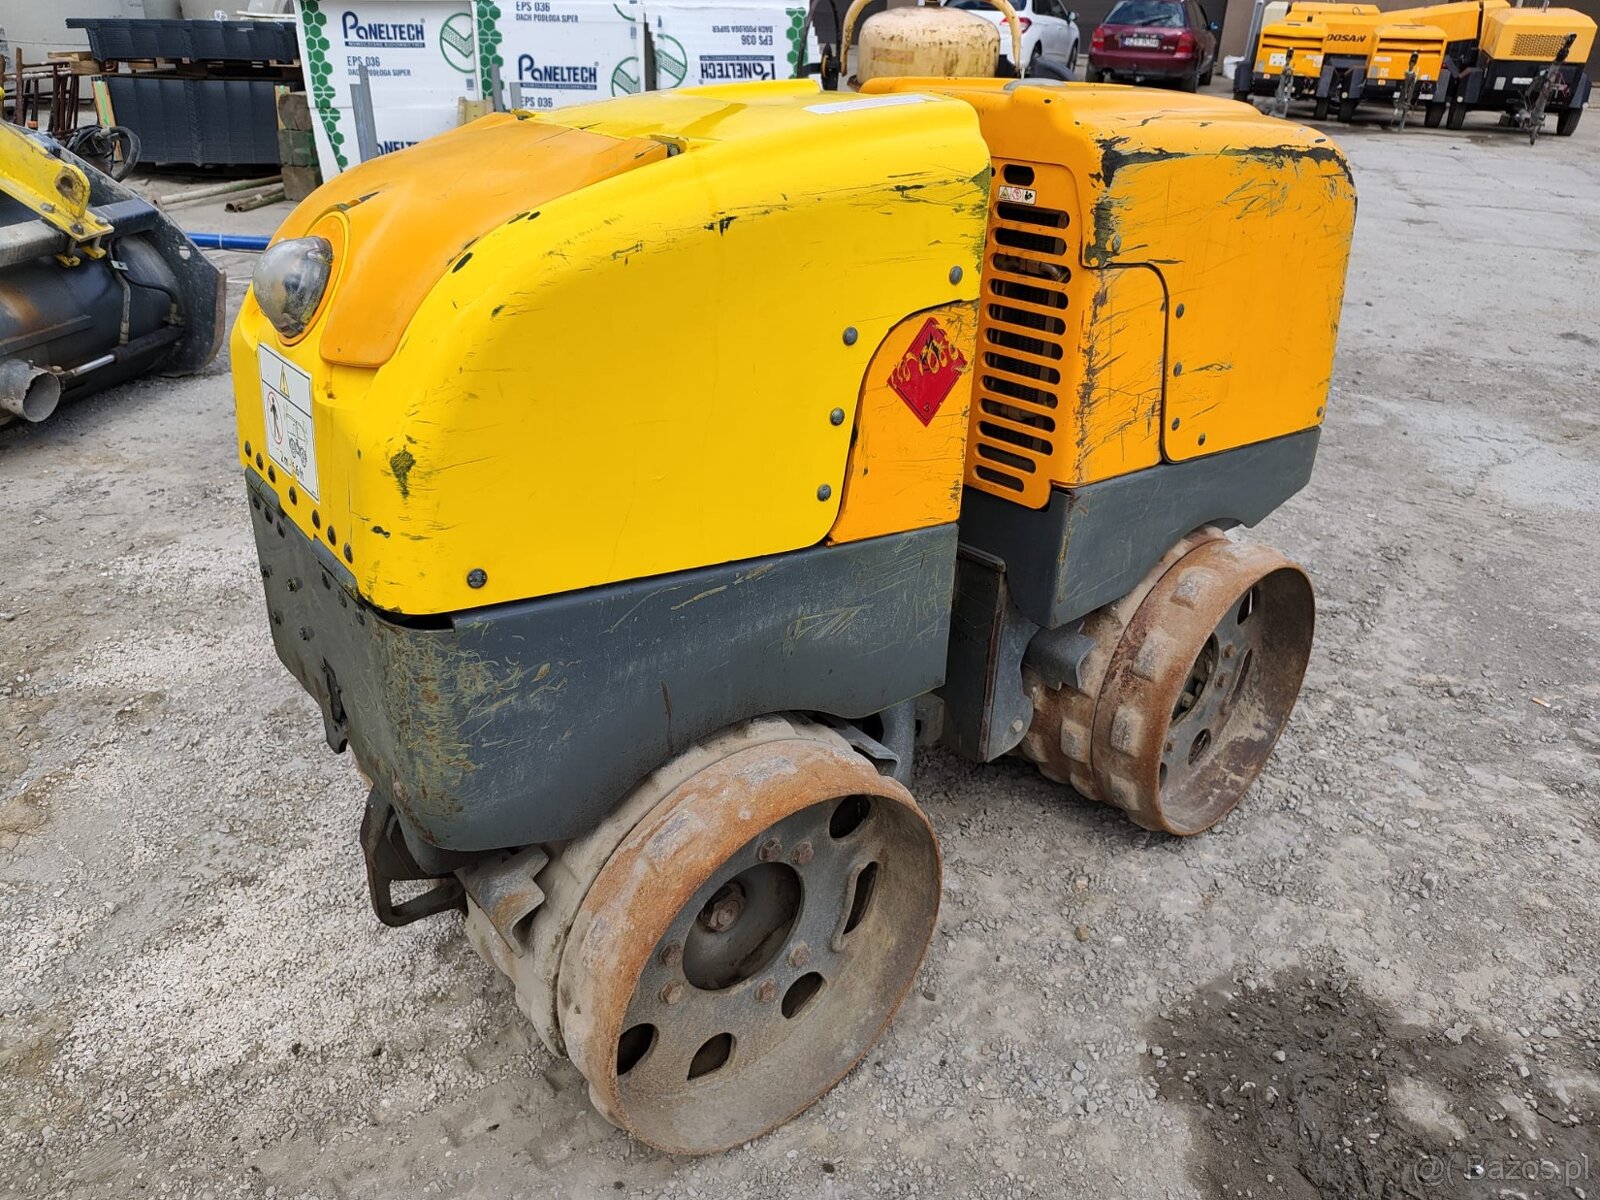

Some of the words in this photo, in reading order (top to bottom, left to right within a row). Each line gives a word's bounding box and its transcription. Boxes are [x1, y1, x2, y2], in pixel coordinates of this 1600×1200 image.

[516, 2, 532, 12] EPS
[534, 2, 550, 12] 036
[516, 13, 532, 22] DACH
[741, 35, 756, 46] 036
[758, 35, 773, 46] EPS
[347, 56, 363, 66] EPS
[365, 56, 380, 67] 036
[537, 97, 553, 108] 036
